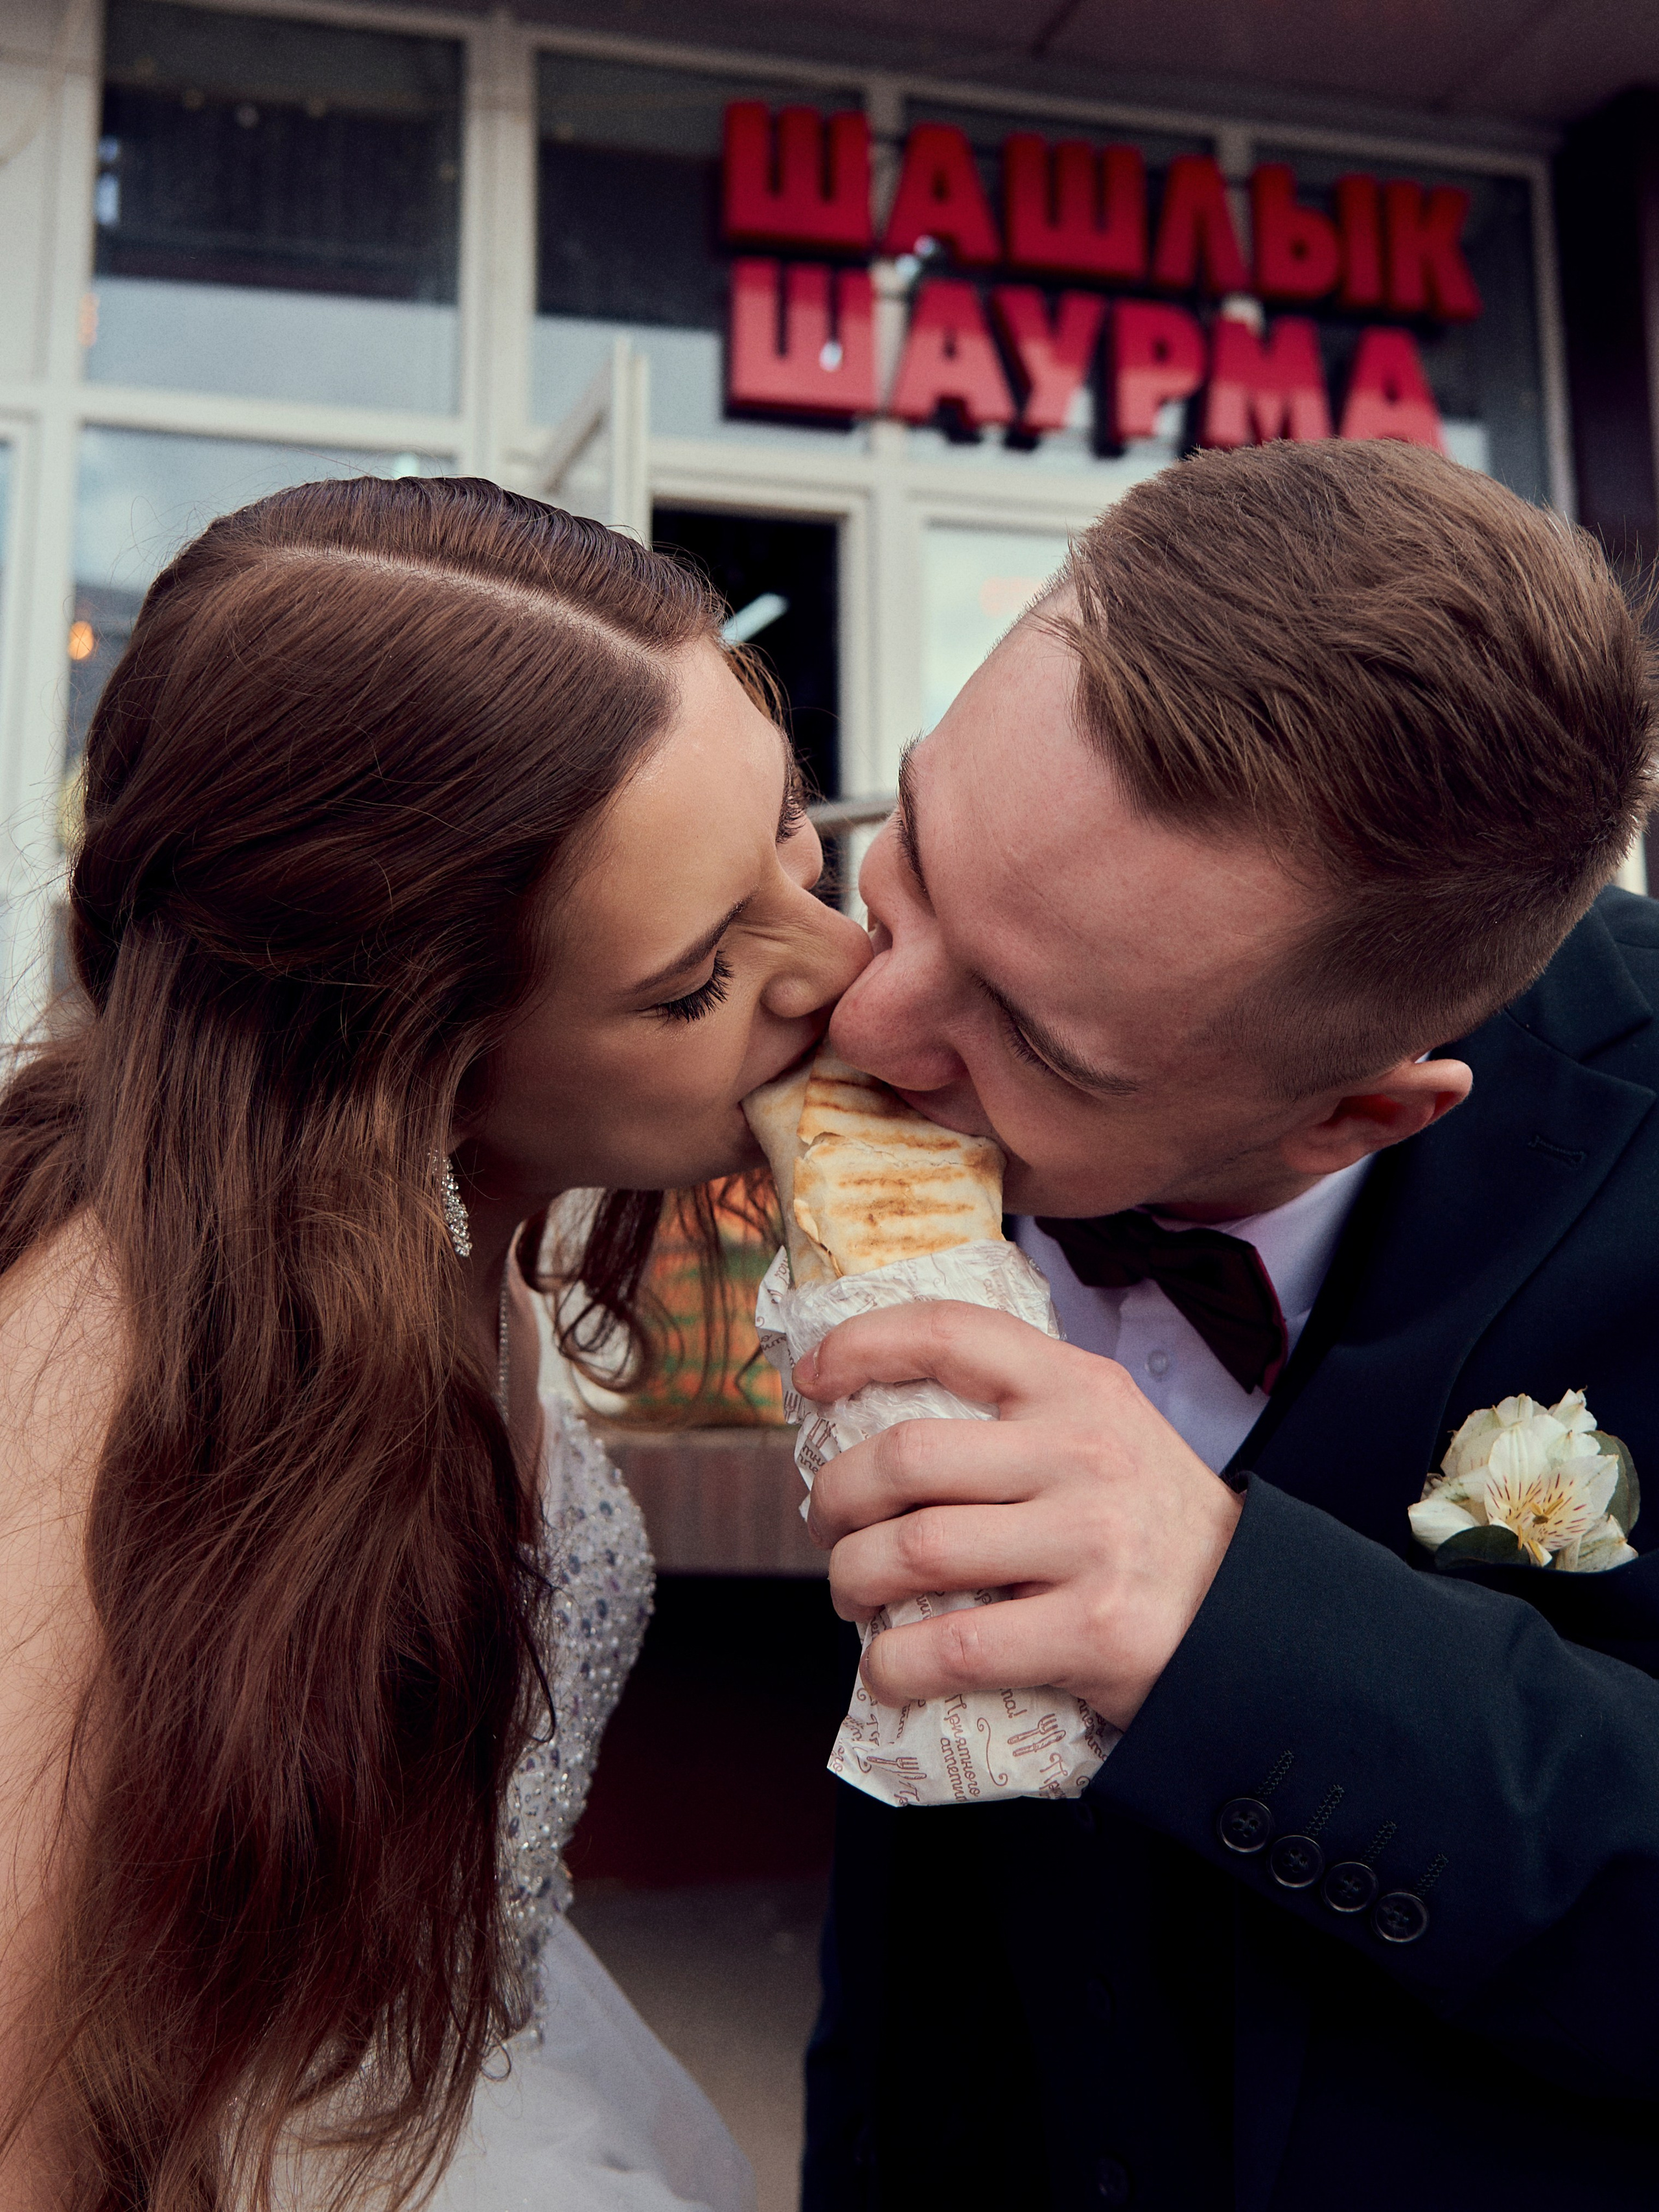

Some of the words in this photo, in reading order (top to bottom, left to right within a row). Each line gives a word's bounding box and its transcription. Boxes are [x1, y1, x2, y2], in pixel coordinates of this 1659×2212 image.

[724, 99, 1483, 321] ШАШЛЫК
[727, 258, 1450, 456] ШАУРМА
[944, 1693, 980, 1797] Приятного
